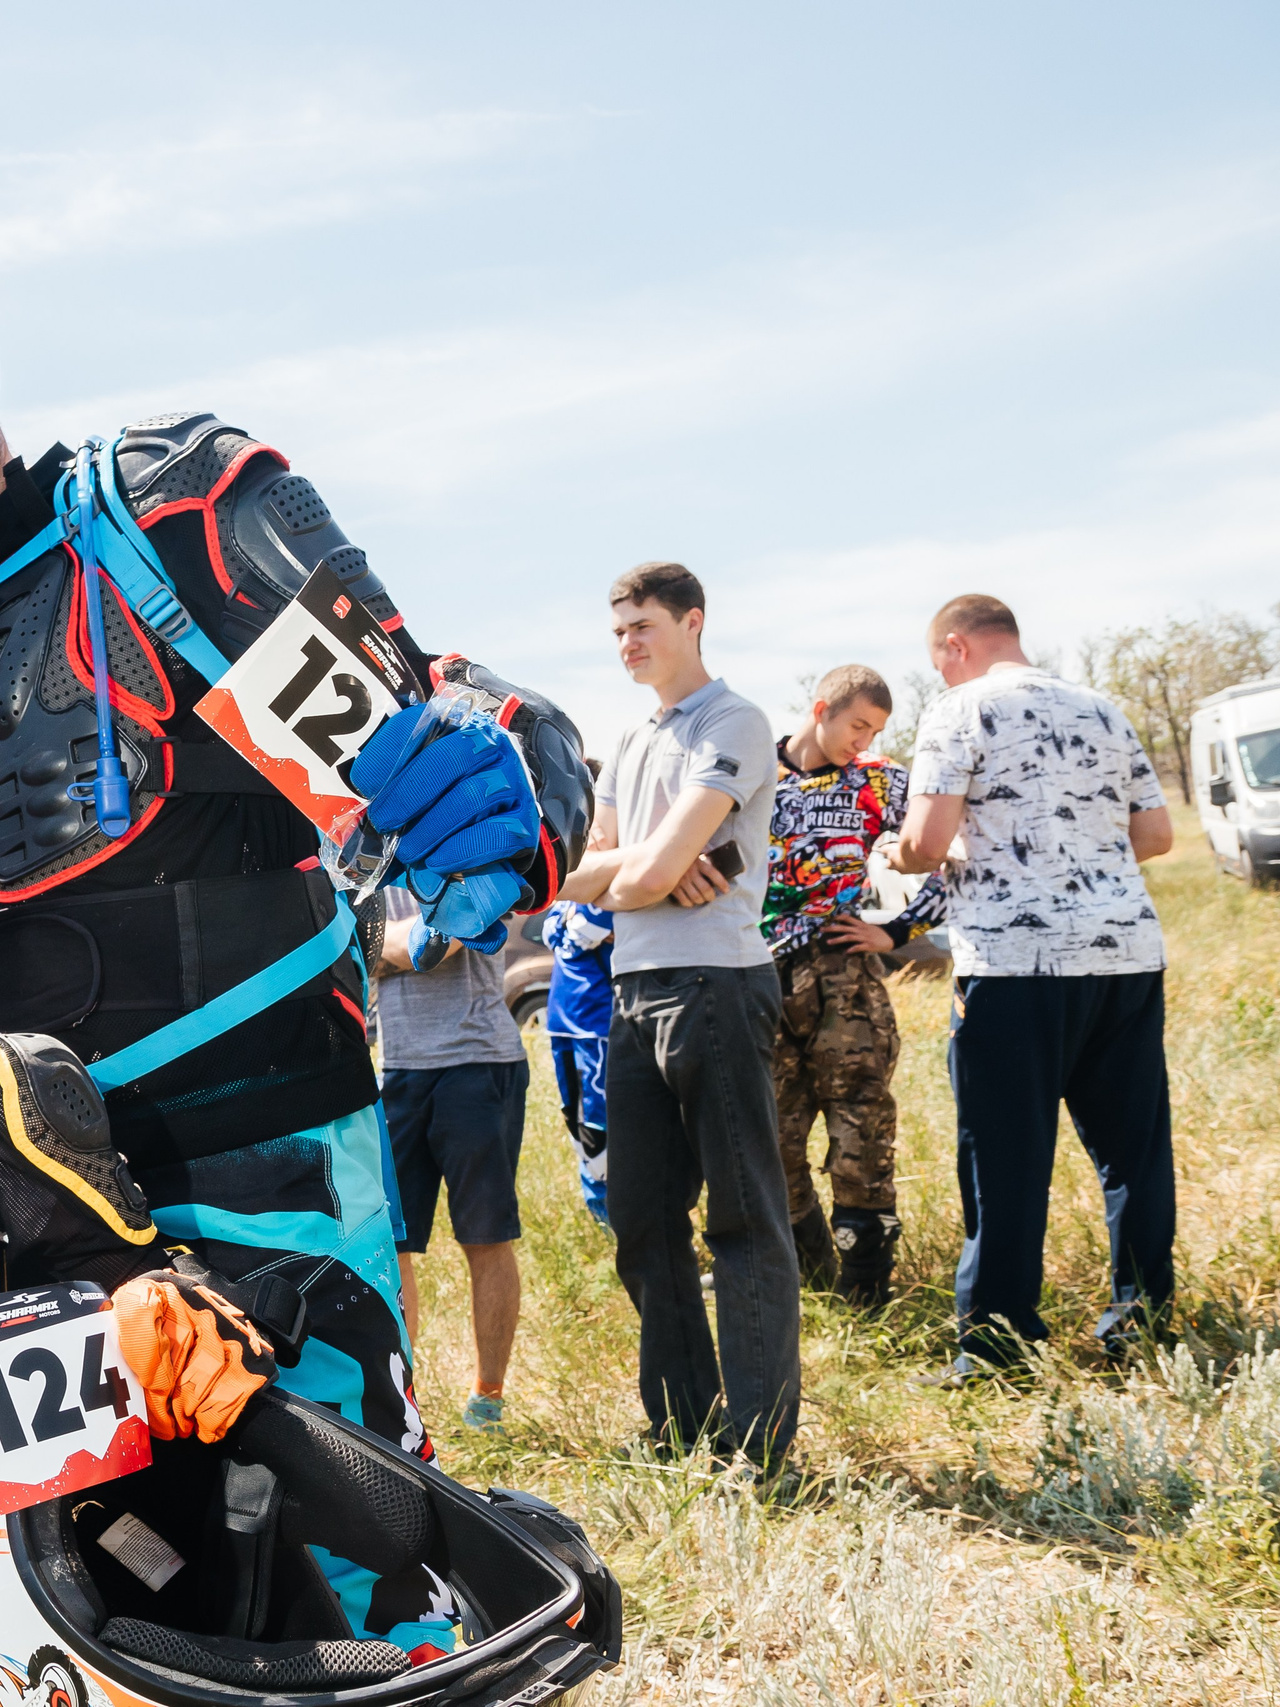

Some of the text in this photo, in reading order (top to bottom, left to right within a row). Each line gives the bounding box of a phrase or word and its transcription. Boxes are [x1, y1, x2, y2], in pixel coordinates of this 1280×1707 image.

[361, 634, 404, 687] SHARMAX
[384, 671, 400, 691] MOTORS
[267, 633, 389, 799] 12
[808, 811, 861, 829] RIDERS
[38, 1309, 61, 1319] MOTORS
